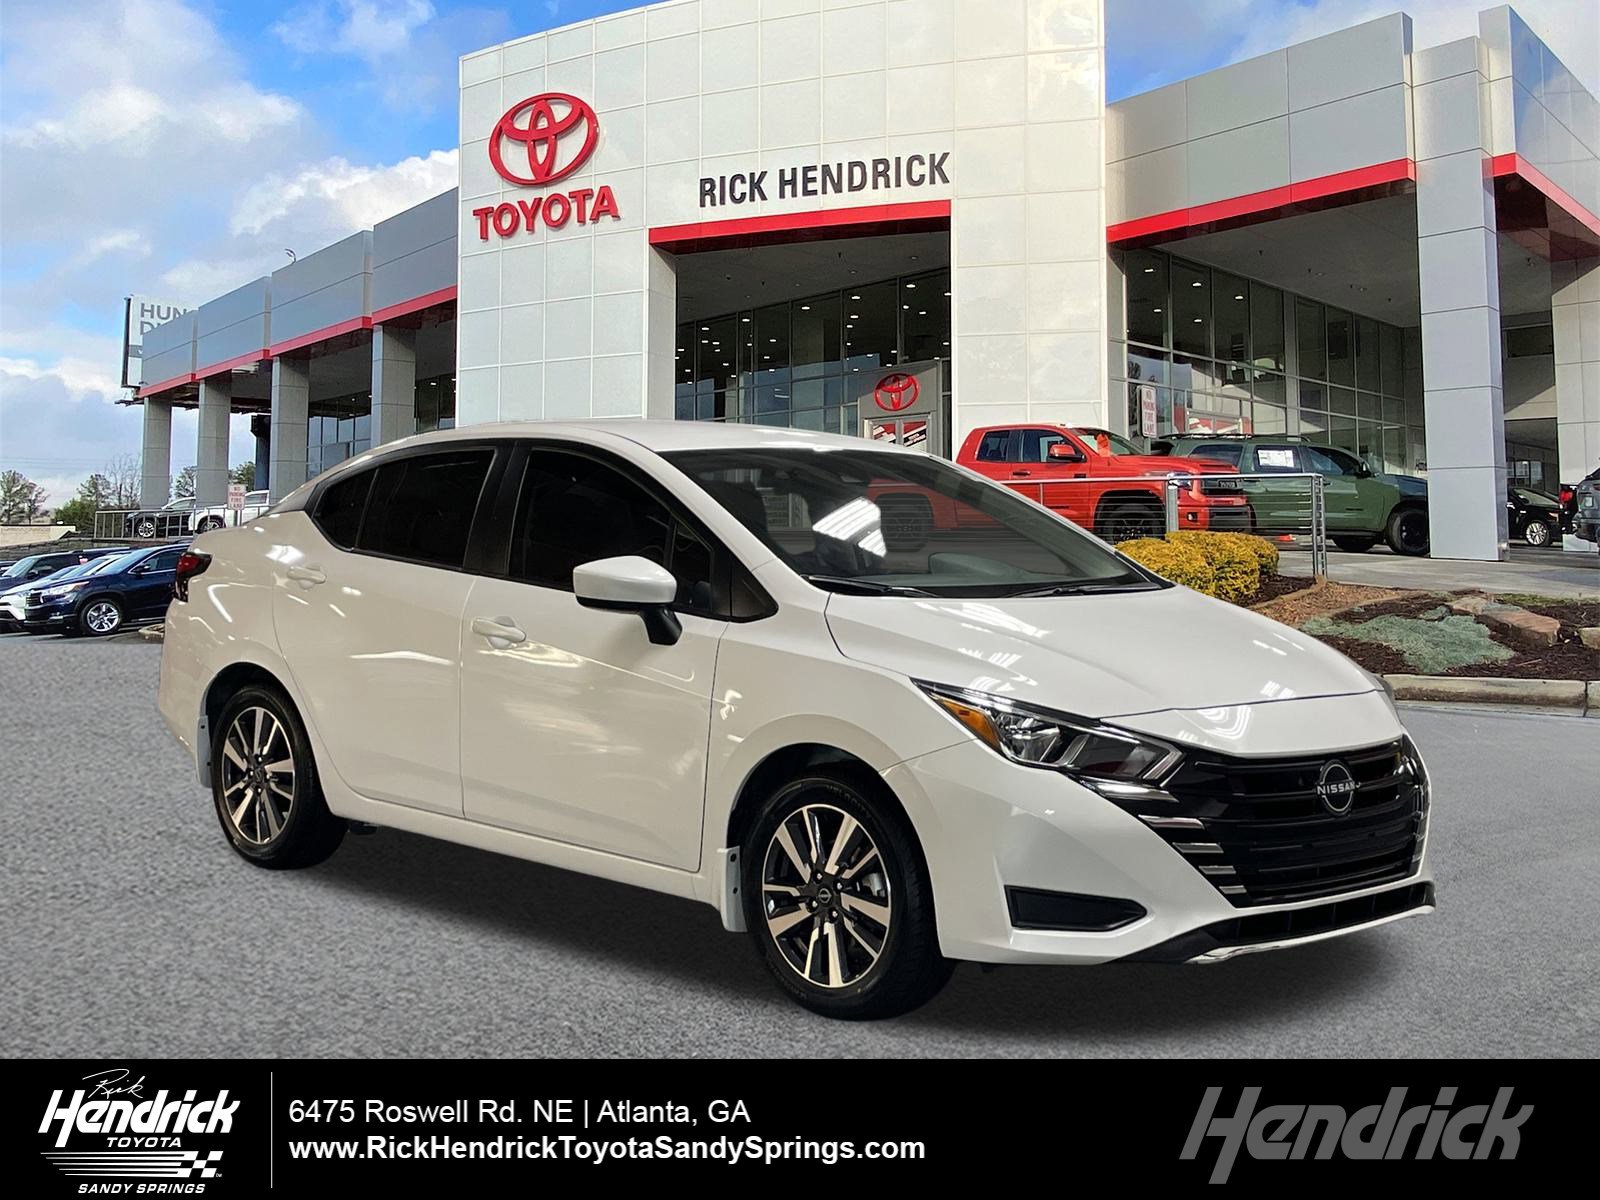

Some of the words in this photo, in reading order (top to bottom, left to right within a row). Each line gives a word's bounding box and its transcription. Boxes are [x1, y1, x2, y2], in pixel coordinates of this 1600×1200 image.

[699, 170, 768, 208] RICK
[779, 152, 951, 200] HENDRICK
[473, 185, 620, 241] TOYOTA
[1316, 781, 1356, 795] NISSAN
